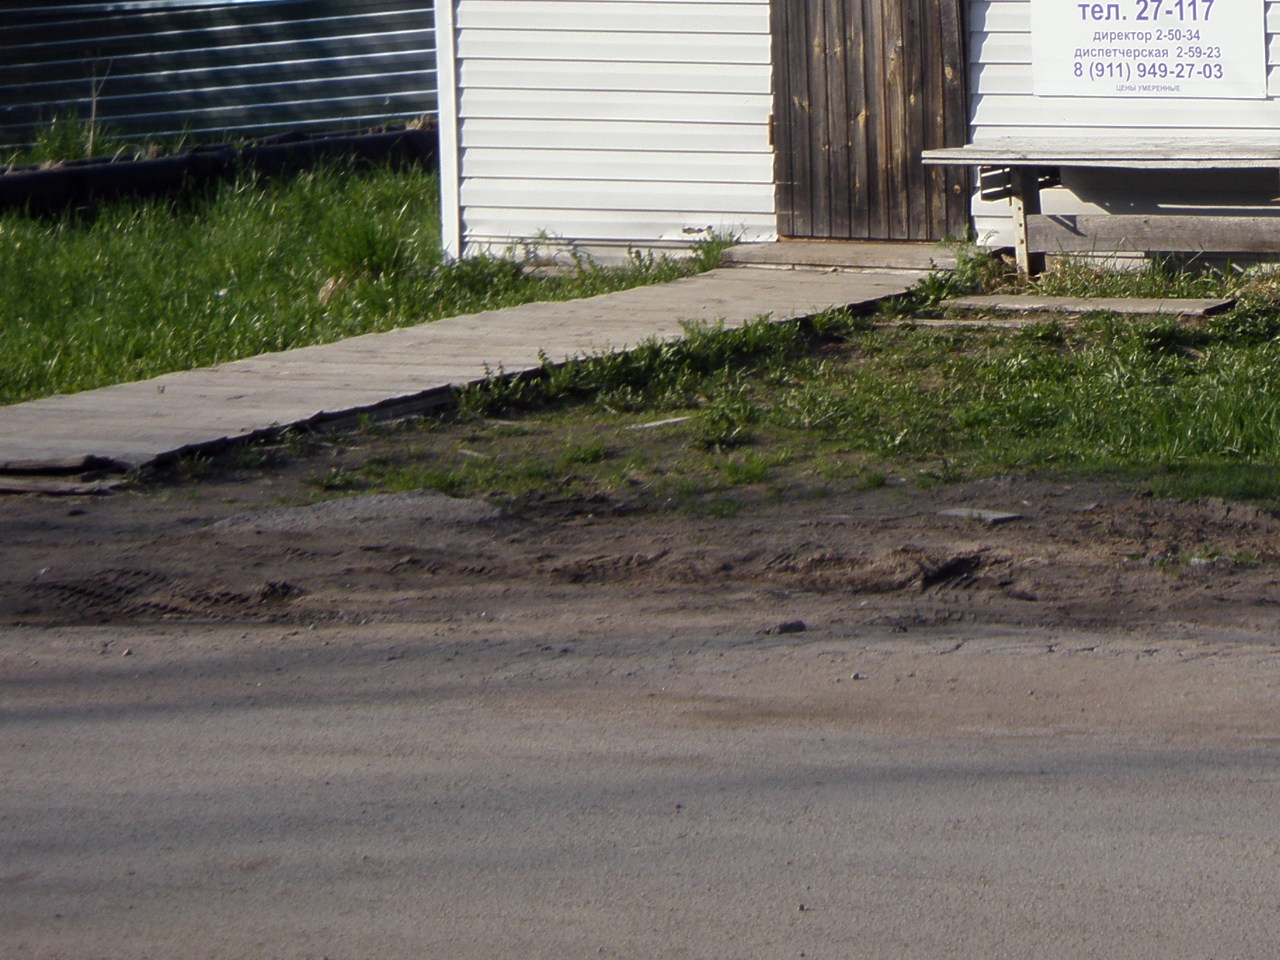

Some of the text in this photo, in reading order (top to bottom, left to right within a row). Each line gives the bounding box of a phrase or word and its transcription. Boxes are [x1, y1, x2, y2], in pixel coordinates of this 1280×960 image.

[1078, 3, 1128, 21] тел.
[1093, 29, 1201, 43] директор 2-50-34
[1074, 46, 1221, 60] диспетчерская 2-59-23
[1073, 62, 1224, 82] 8 (911) 949-27-03
[1116, 84, 1180, 92] ЦЕНЫ УМЕРЕННЫЕ
